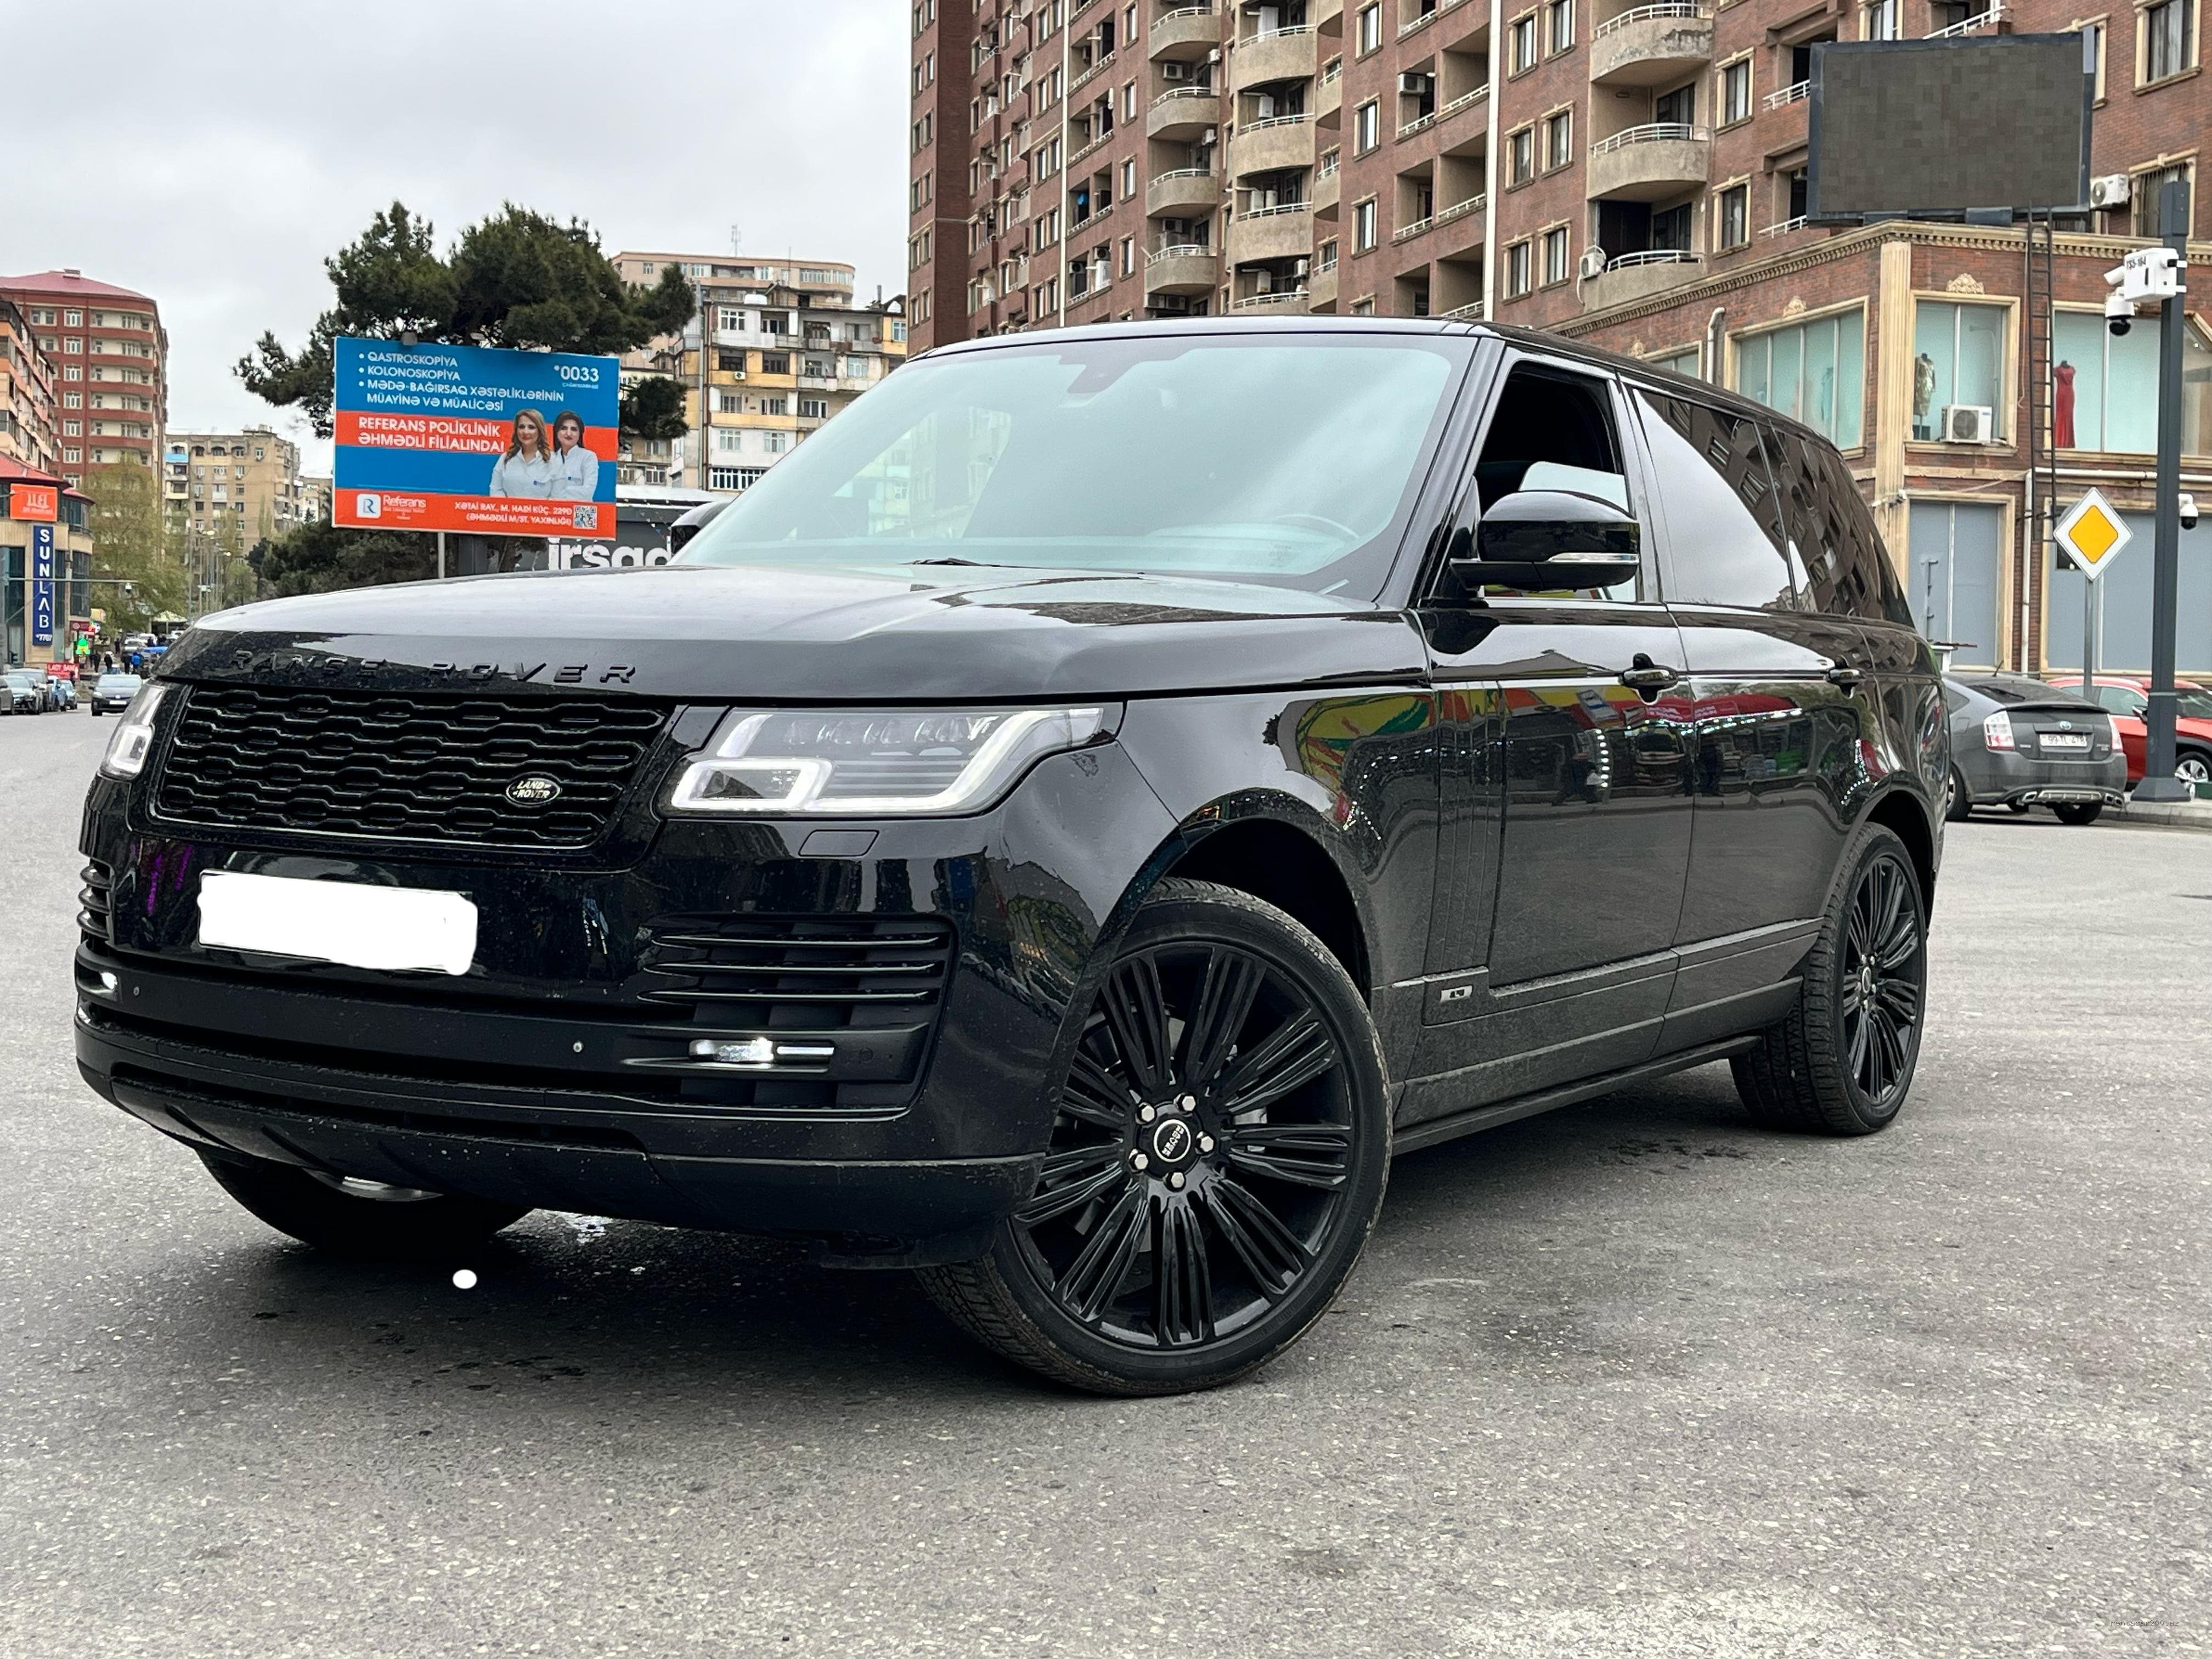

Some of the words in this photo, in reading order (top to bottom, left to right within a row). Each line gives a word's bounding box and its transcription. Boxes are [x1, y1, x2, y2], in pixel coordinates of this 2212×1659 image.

[368, 352, 458, 367] QASTROSKOPİYA
[368, 365, 460, 381] KOLONOSKOPİYA
[367, 392, 420, 406] MÜAYİNƏ
[422, 397, 440, 407] VƏ
[443, 397, 503, 411] MÜALİCƏSİ
[359, 416, 426, 433] REFERANS
[429, 420, 500, 437] POLİKLİNİK
[358, 432, 425, 448] ƏHMƏDLİ
[429, 435, 504, 453] FİLİALINDA!
[383, 494, 427, 509] Referans
[230, 650, 385, 676] RANGE
[429, 662, 635, 684] ROVER
[517, 780, 545, 789] LAND
[517, 789, 550, 798] ROVER
